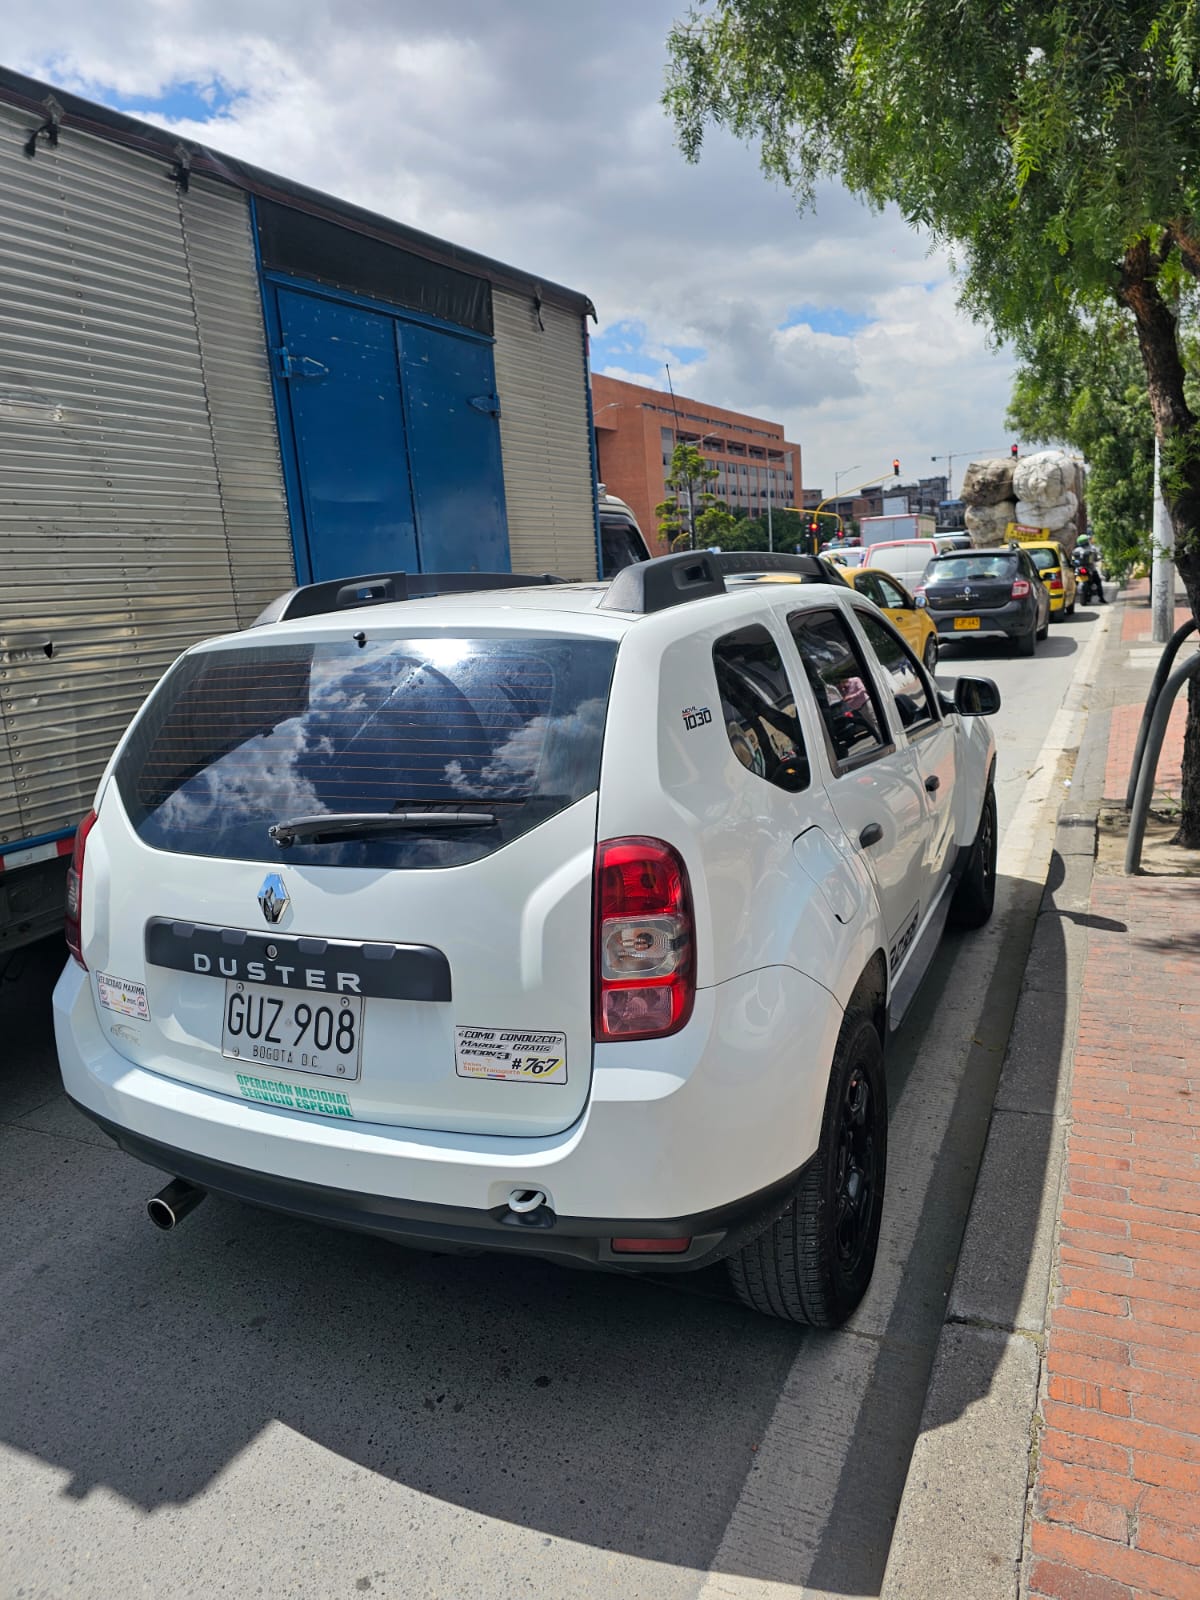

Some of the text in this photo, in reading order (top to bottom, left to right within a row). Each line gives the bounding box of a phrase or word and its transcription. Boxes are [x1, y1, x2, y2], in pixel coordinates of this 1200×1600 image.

[683, 709, 713, 731] 1030
[193, 953, 362, 993] DUSTER
[122, 983, 145, 996] MAXIMA
[227, 992, 355, 1055] GUZ 908
[252, 1044, 293, 1064] BOGOTA
[236, 1074, 350, 1106] OPERACIÓN NACIONAL
[240, 1085, 354, 1118] SERVICIO ESPECIAL
